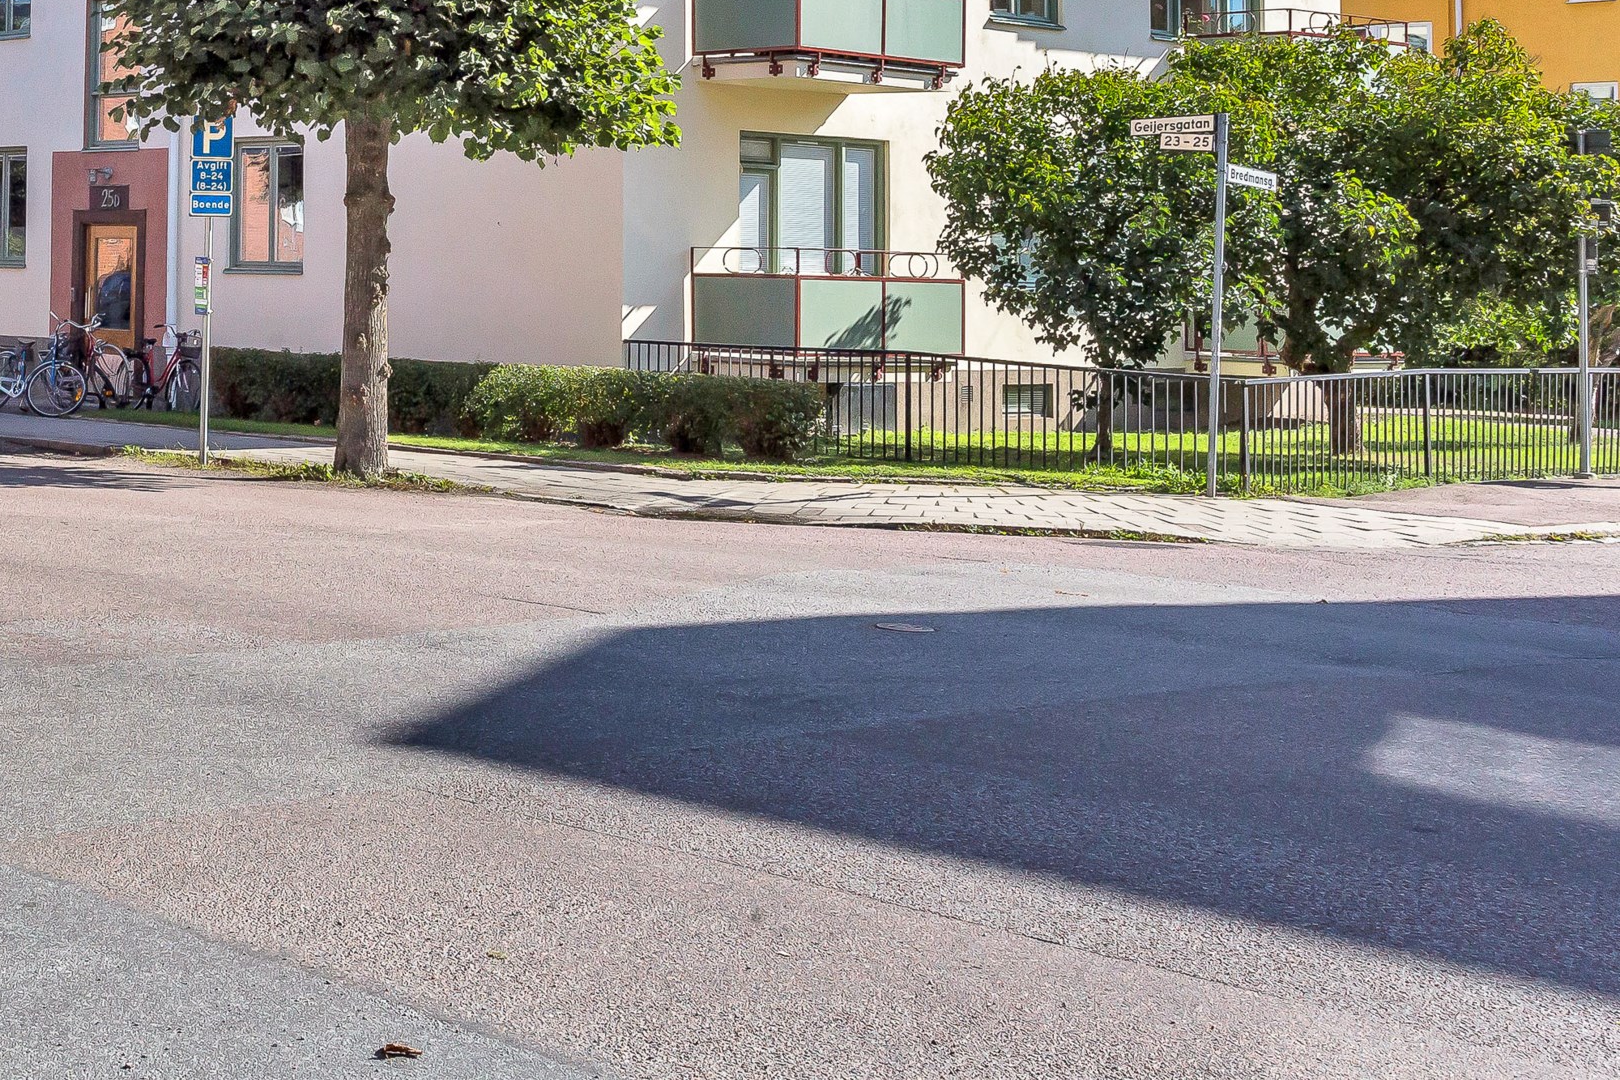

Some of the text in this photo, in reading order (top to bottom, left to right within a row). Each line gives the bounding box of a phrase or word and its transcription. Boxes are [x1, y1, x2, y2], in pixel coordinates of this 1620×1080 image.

[1134, 119, 1210, 133] Geijersgatan
[203, 118, 227, 154] P
[1164, 135, 1180, 147] 23
[1193, 136, 1210, 148] 25
[196, 161, 228, 171] Avgift
[200, 172, 224, 180] 8-24
[196, 181, 227, 191] (8-24)
[192, 200, 230, 209] Boende
